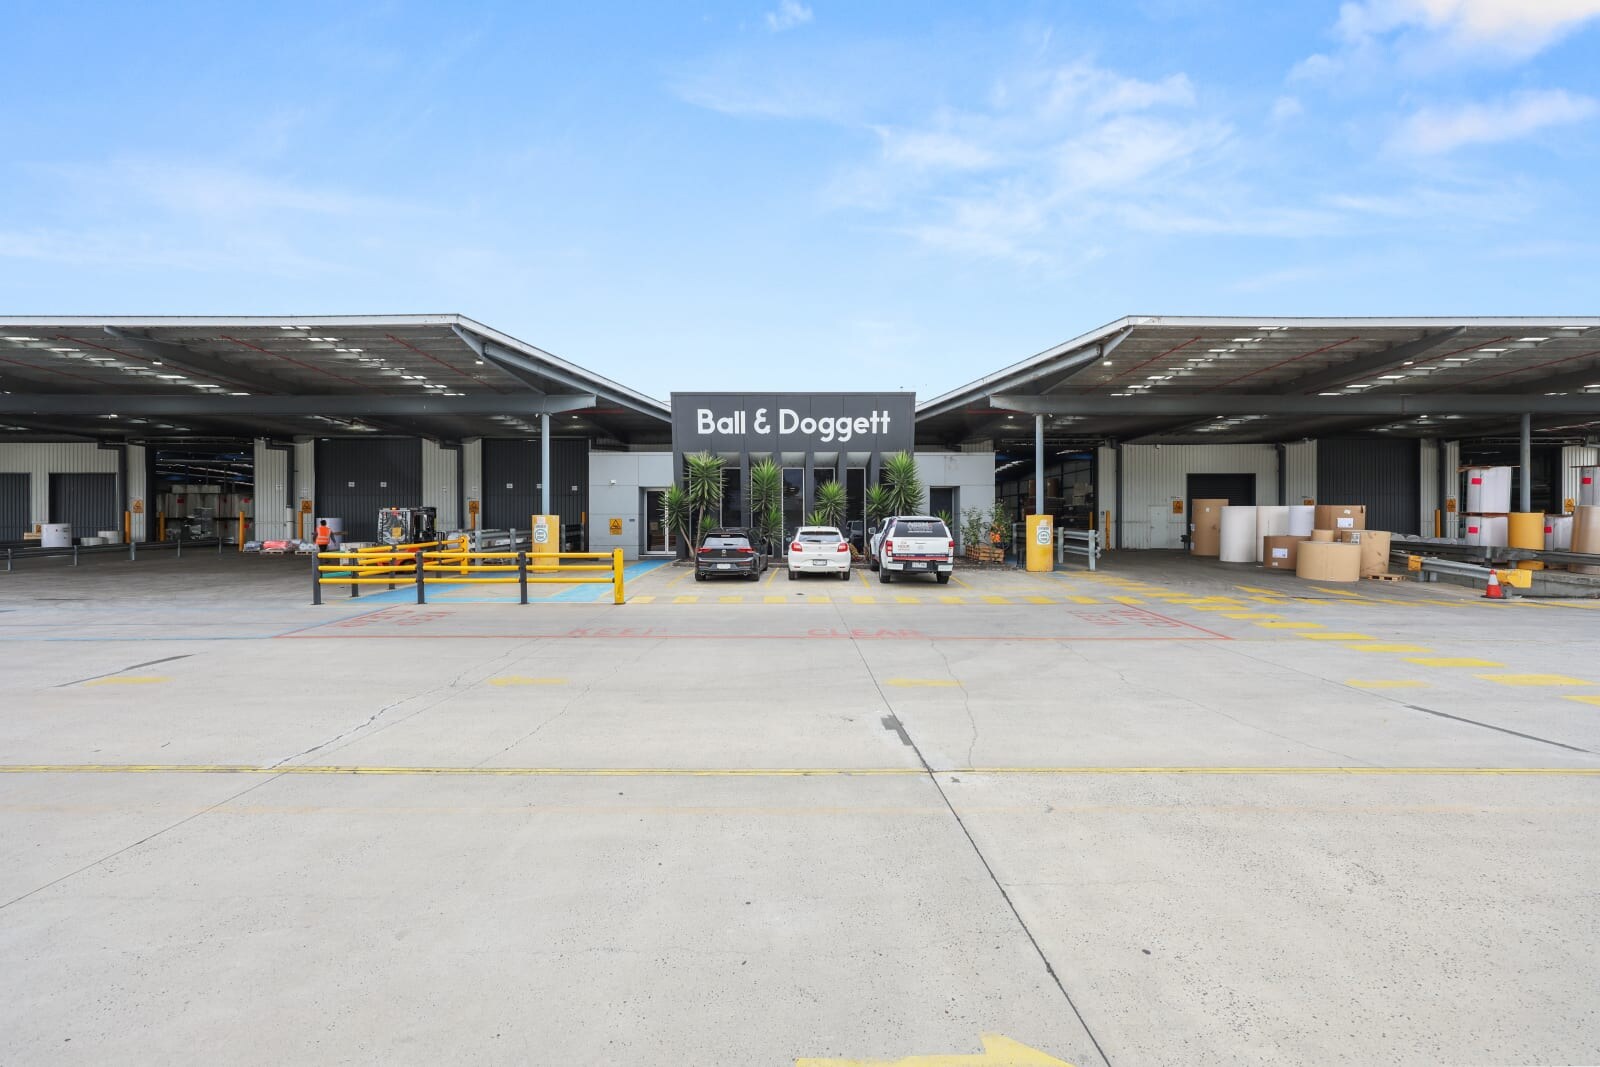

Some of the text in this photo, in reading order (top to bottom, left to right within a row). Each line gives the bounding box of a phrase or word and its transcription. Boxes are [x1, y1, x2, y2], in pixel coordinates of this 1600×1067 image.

[697, 407, 891, 443] Ball & Doggett
